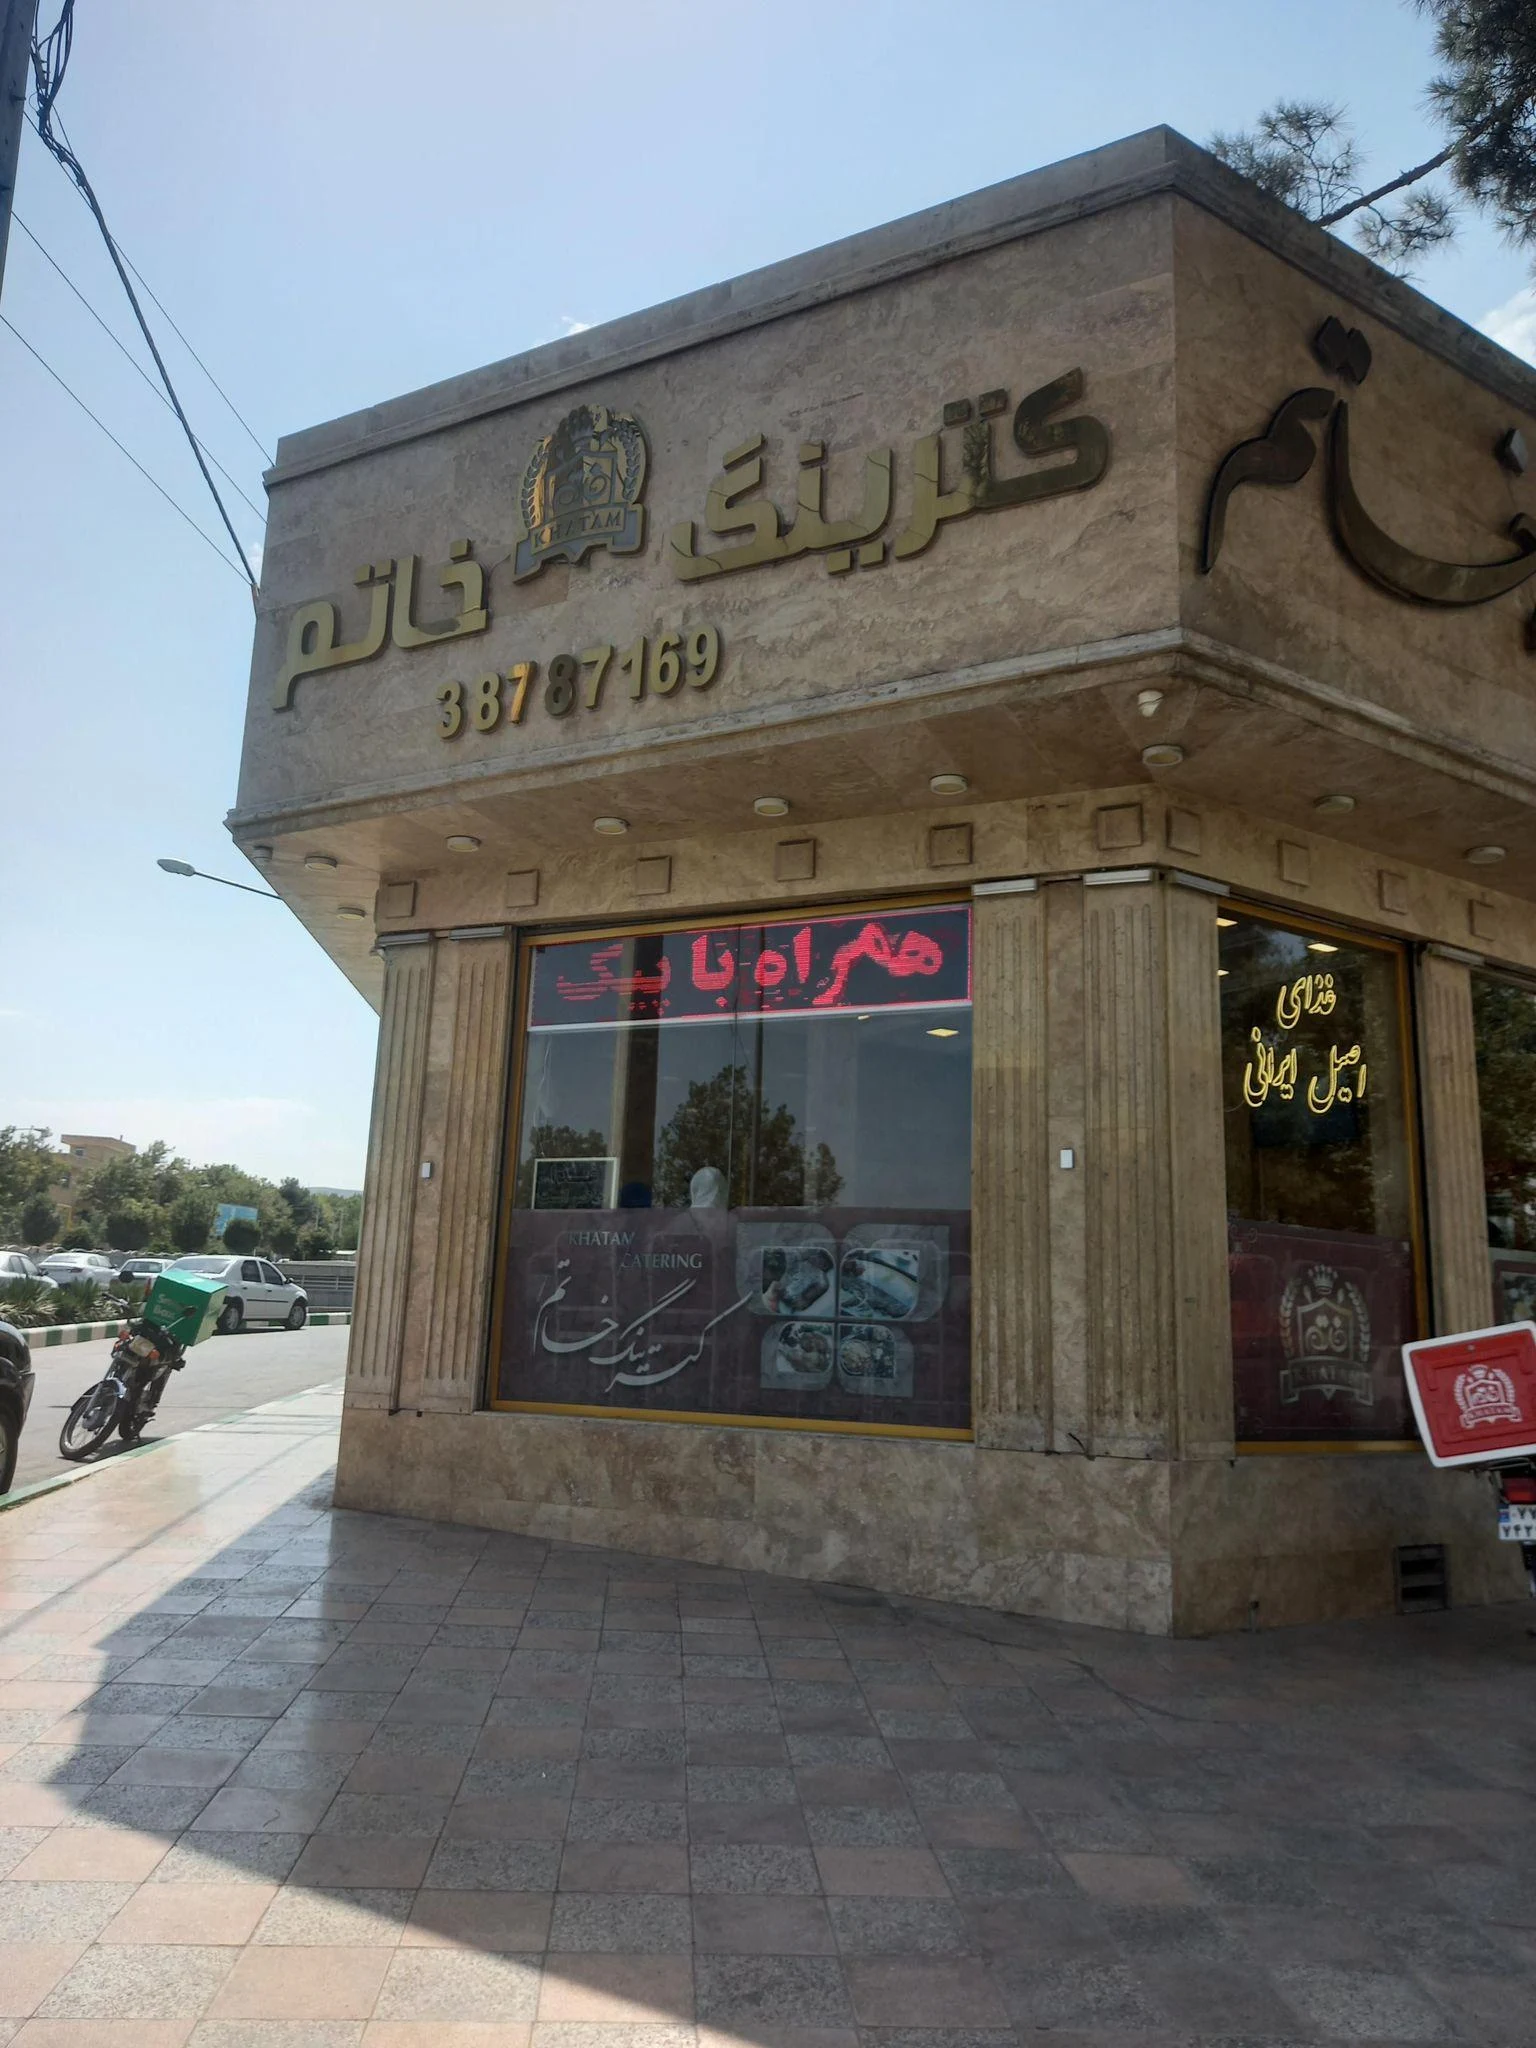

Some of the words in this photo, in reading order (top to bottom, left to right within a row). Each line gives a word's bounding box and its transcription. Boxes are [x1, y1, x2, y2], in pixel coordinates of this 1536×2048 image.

[670, 367, 1112, 582] کترینگ
[532, 510, 622, 548] KHATAM
[271, 537, 490, 712] خاتم
[435, 623, 721, 741] 38787169
[691, 935, 735, 1009] با
[754, 922, 943, 1005] همراه
[1276, 973, 1338, 1029] غذای
[1243, 1026, 1299, 1108] ایرانی
[1307, 1044, 1367, 1114] اصیل
[620, 1252, 703, 1269] CATERING
[533, 1258, 620, 1354] خاتم
[588, 1278, 753, 1393] کترینگ
